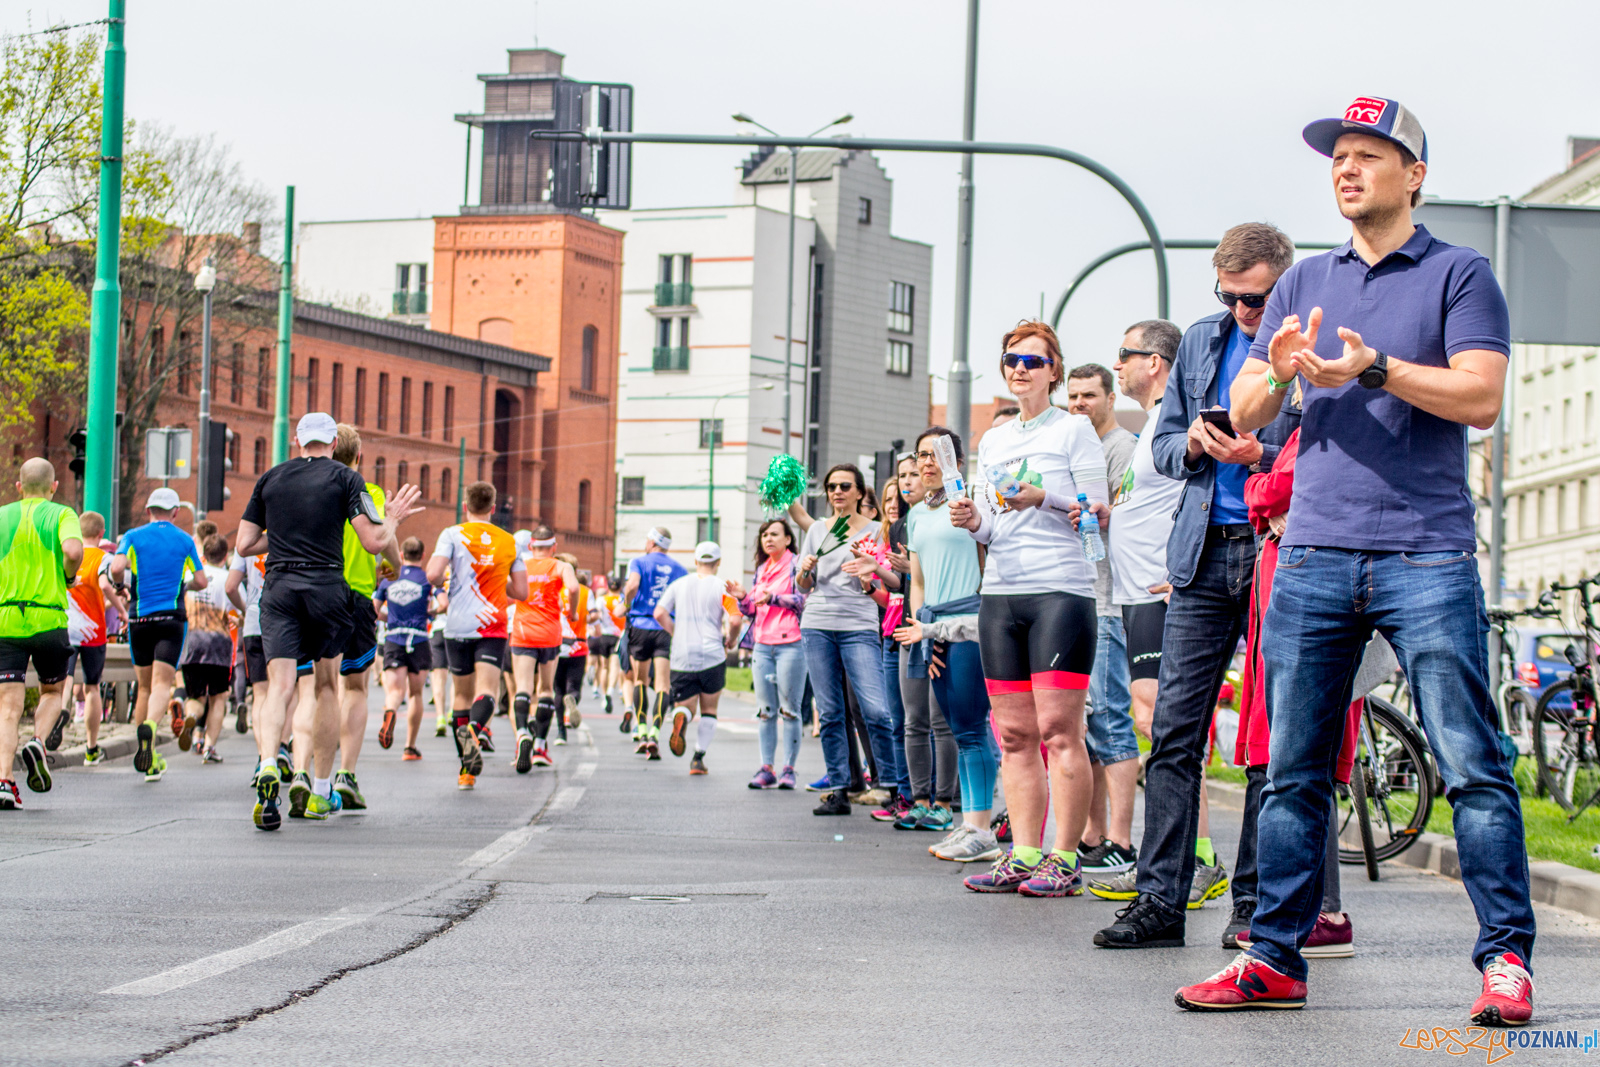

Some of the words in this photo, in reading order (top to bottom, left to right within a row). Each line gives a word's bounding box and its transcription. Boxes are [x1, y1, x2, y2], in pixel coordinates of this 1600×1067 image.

[1347, 107, 1379, 122] TYR
[1133, 652, 1163, 663] BTW
[1233, 972, 1269, 1000] N
